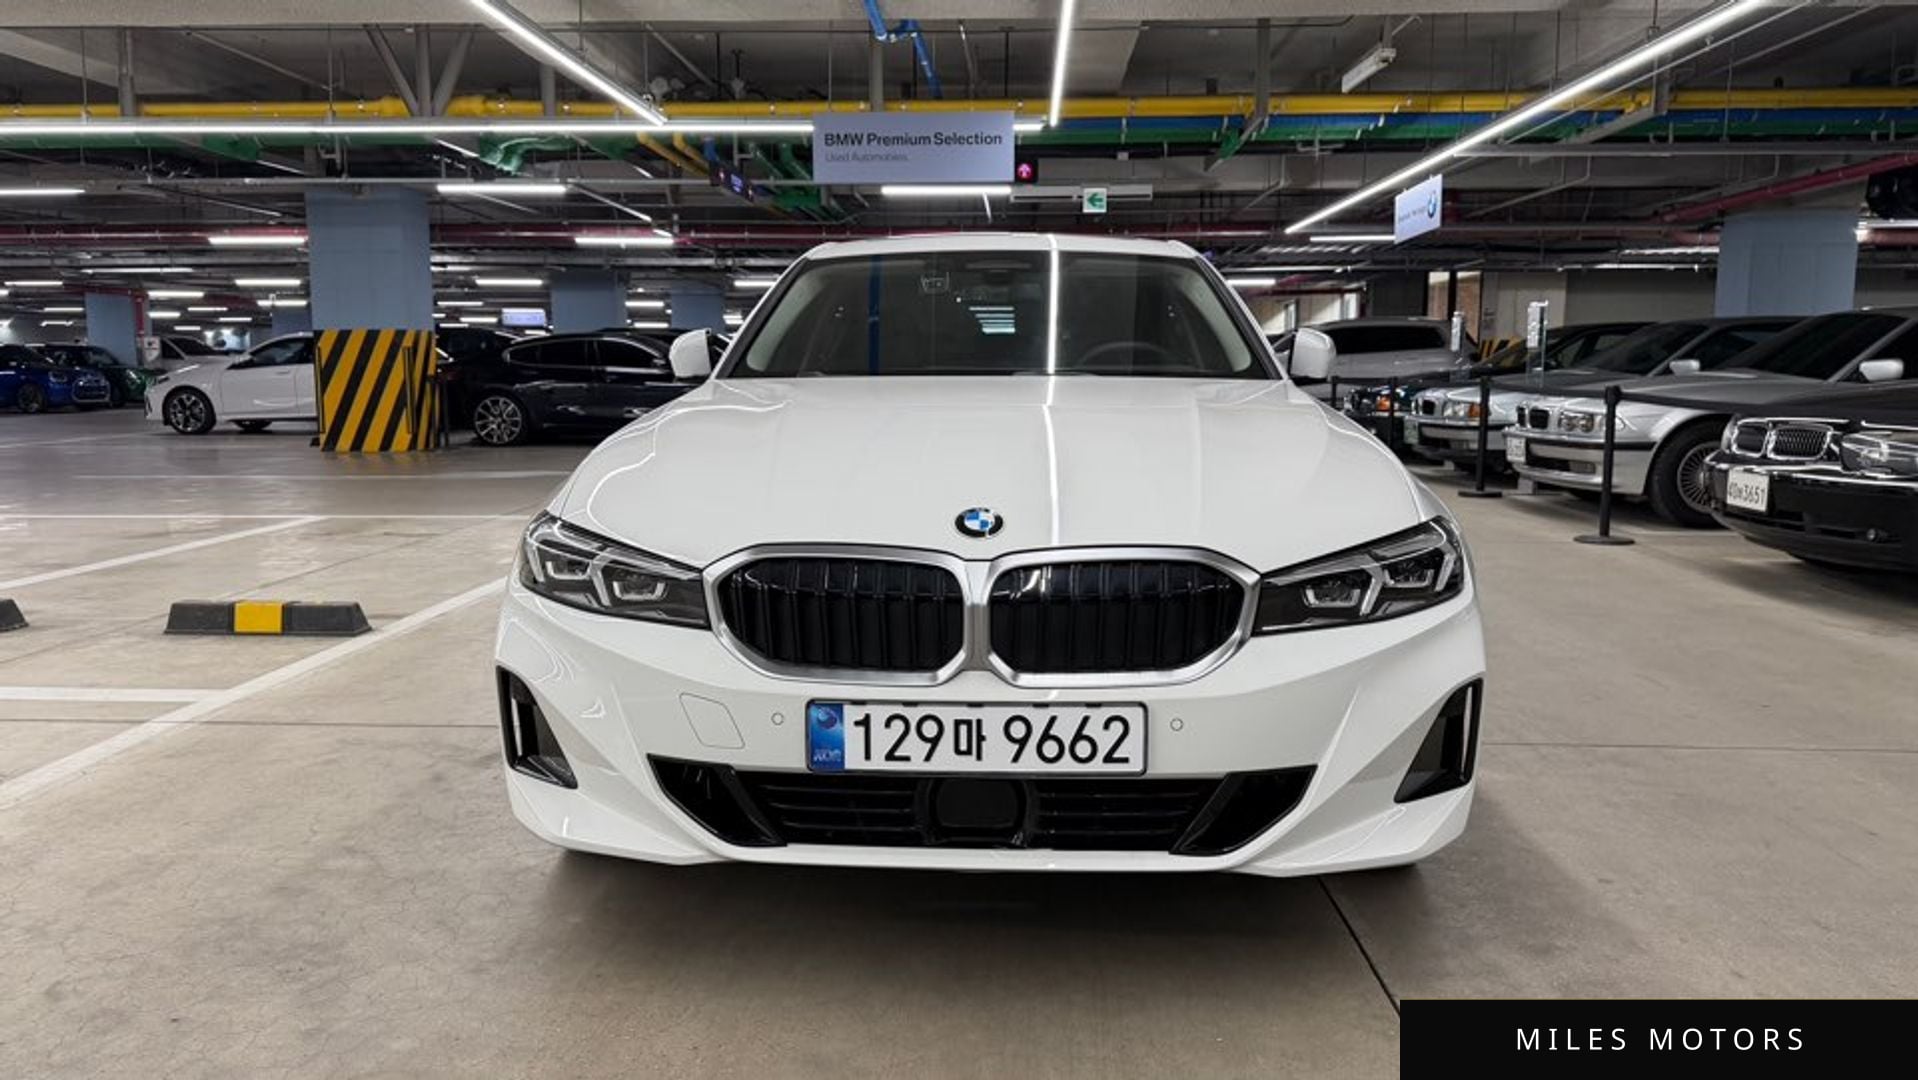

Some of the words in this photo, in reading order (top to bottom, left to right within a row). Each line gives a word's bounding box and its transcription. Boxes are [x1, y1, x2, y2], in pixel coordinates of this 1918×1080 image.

[824, 133, 864, 146] BMW
[866, 132, 931, 146] Premium
[934, 131, 1002, 145] Selection
[853, 713, 987, 763] 129마
[1002, 714, 1131, 765] 9662
